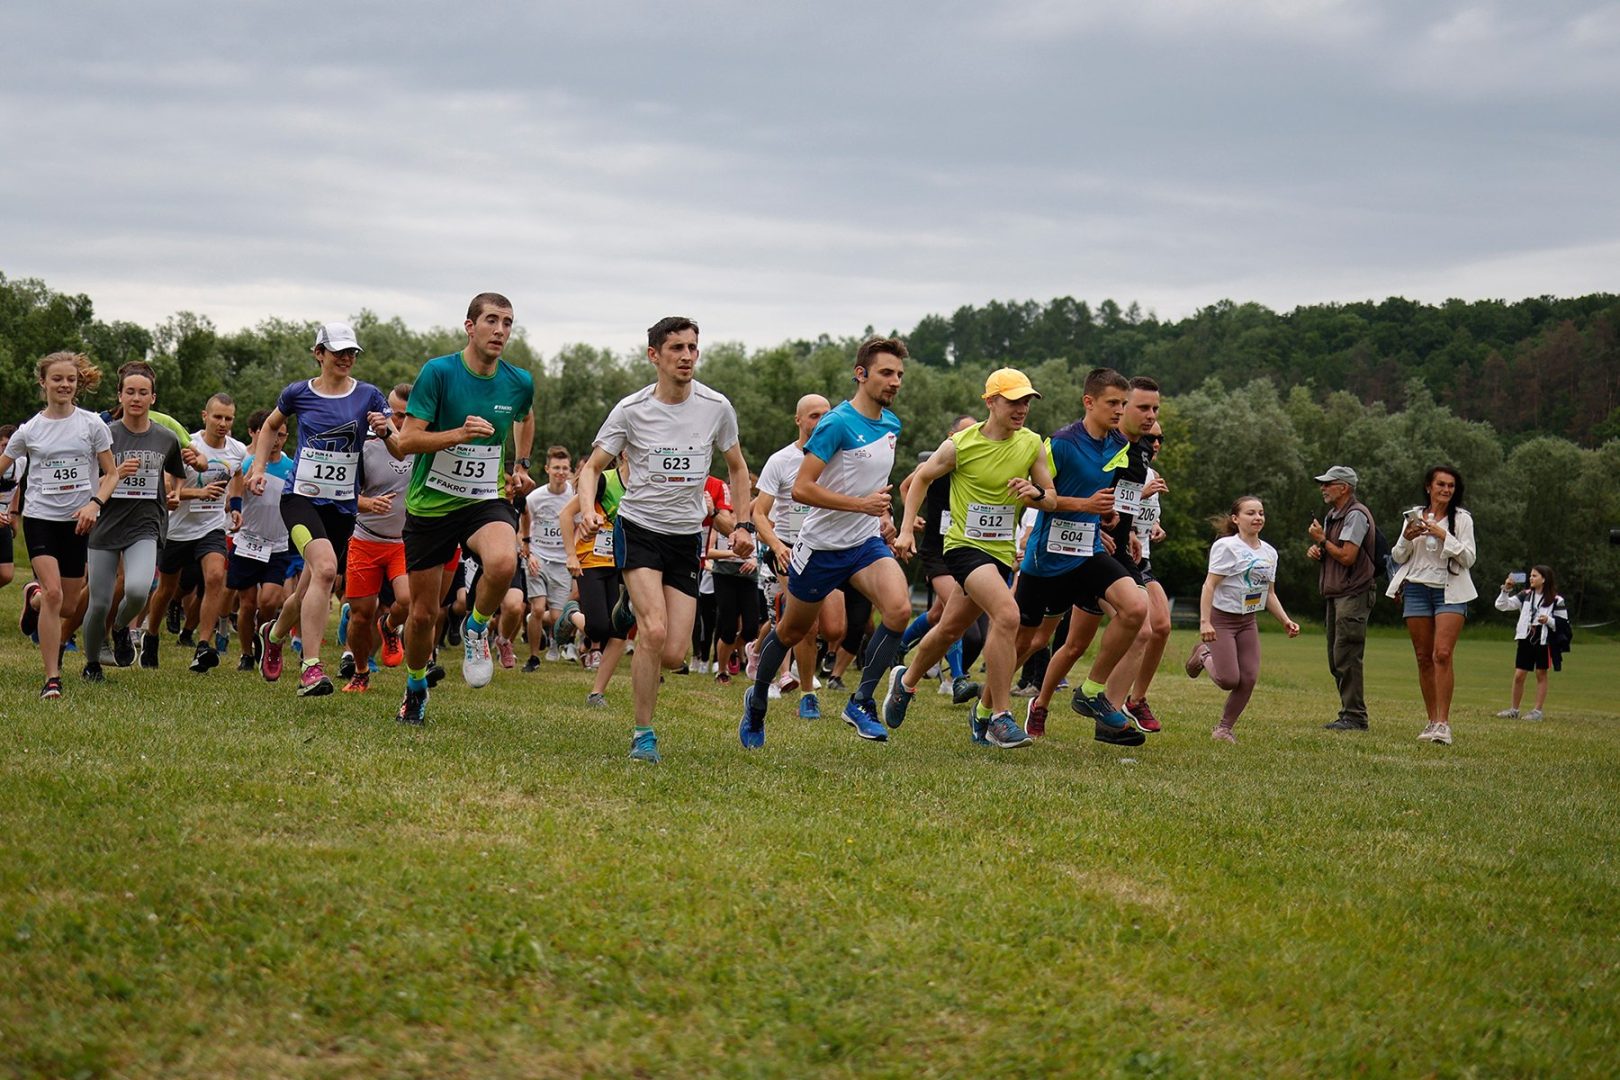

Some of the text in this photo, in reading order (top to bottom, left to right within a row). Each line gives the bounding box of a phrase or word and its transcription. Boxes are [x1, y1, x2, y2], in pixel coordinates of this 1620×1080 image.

[451, 460, 485, 478] 153
[663, 457, 690, 470] 623
[53, 468, 78, 480] 436
[313, 464, 347, 481] 128
[123, 477, 146, 487] 438
[436, 478, 467, 493] FAKRO
[1120, 489, 1134, 501] 510
[1138, 507, 1155, 521] 206
[979, 515, 1003, 527] 612
[544, 527, 562, 537] 160
[1060, 530, 1083, 542] 604
[246, 542, 263, 553] 434
